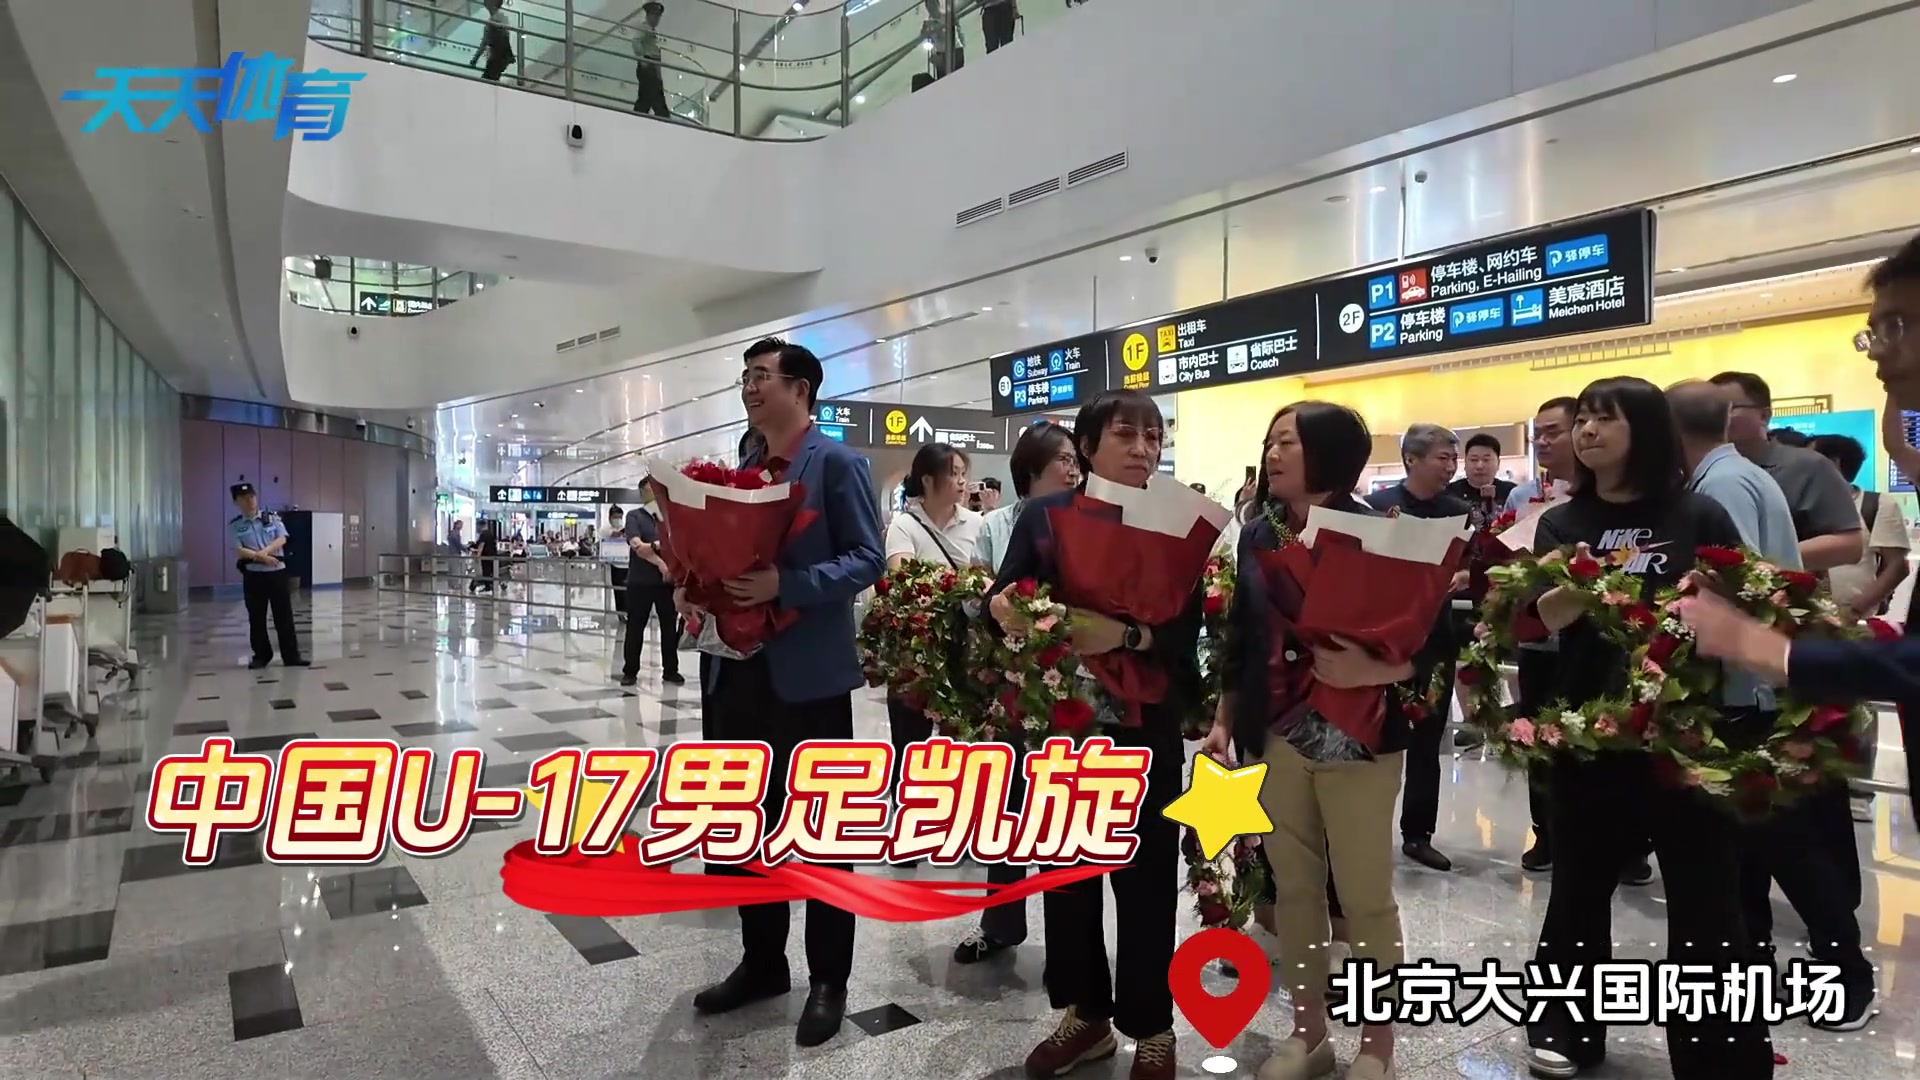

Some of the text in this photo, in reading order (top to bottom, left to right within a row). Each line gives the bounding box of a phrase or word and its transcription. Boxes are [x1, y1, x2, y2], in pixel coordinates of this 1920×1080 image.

[1430, 246, 1538, 283] 停车楼、网约车
[1431, 267, 1542, 298] Parking, E-Hailing
[1371, 283, 1393, 302] P1
[1548, 276, 1625, 307] 美宸酒店
[1549, 297, 1625, 319] Meichen Hotel
[1343, 310, 1361, 327] 2F
[1400, 307, 1446, 330] 停车楼
[1177, 319, 1207, 337] 出租车
[1371, 324, 1395, 342] P2
[1400, 328, 1444, 345] Parking
[1126, 342, 1145, 361] 1F
[1178, 337, 1195, 349] Taxi
[1250, 336, 1298, 359] 省际巴士
[1027, 355, 1042, 367] 地铁
[1065, 347, 1081, 361] 火车
[1178, 350, 1219, 371] 市内巴士
[1027, 367, 1048, 378] Subway
[1065, 361, 1081, 371] Train
[1250, 357, 1279, 371] Coach
[1178, 369, 1210, 383] City Bus
[1000, 381, 1010, 392] B1
[1028, 381, 1050, 395] 停车楼
[1014, 390, 1027, 404] P3
[1028, 396, 1049, 406] Parking
[888, 416, 904, 428] 1F
